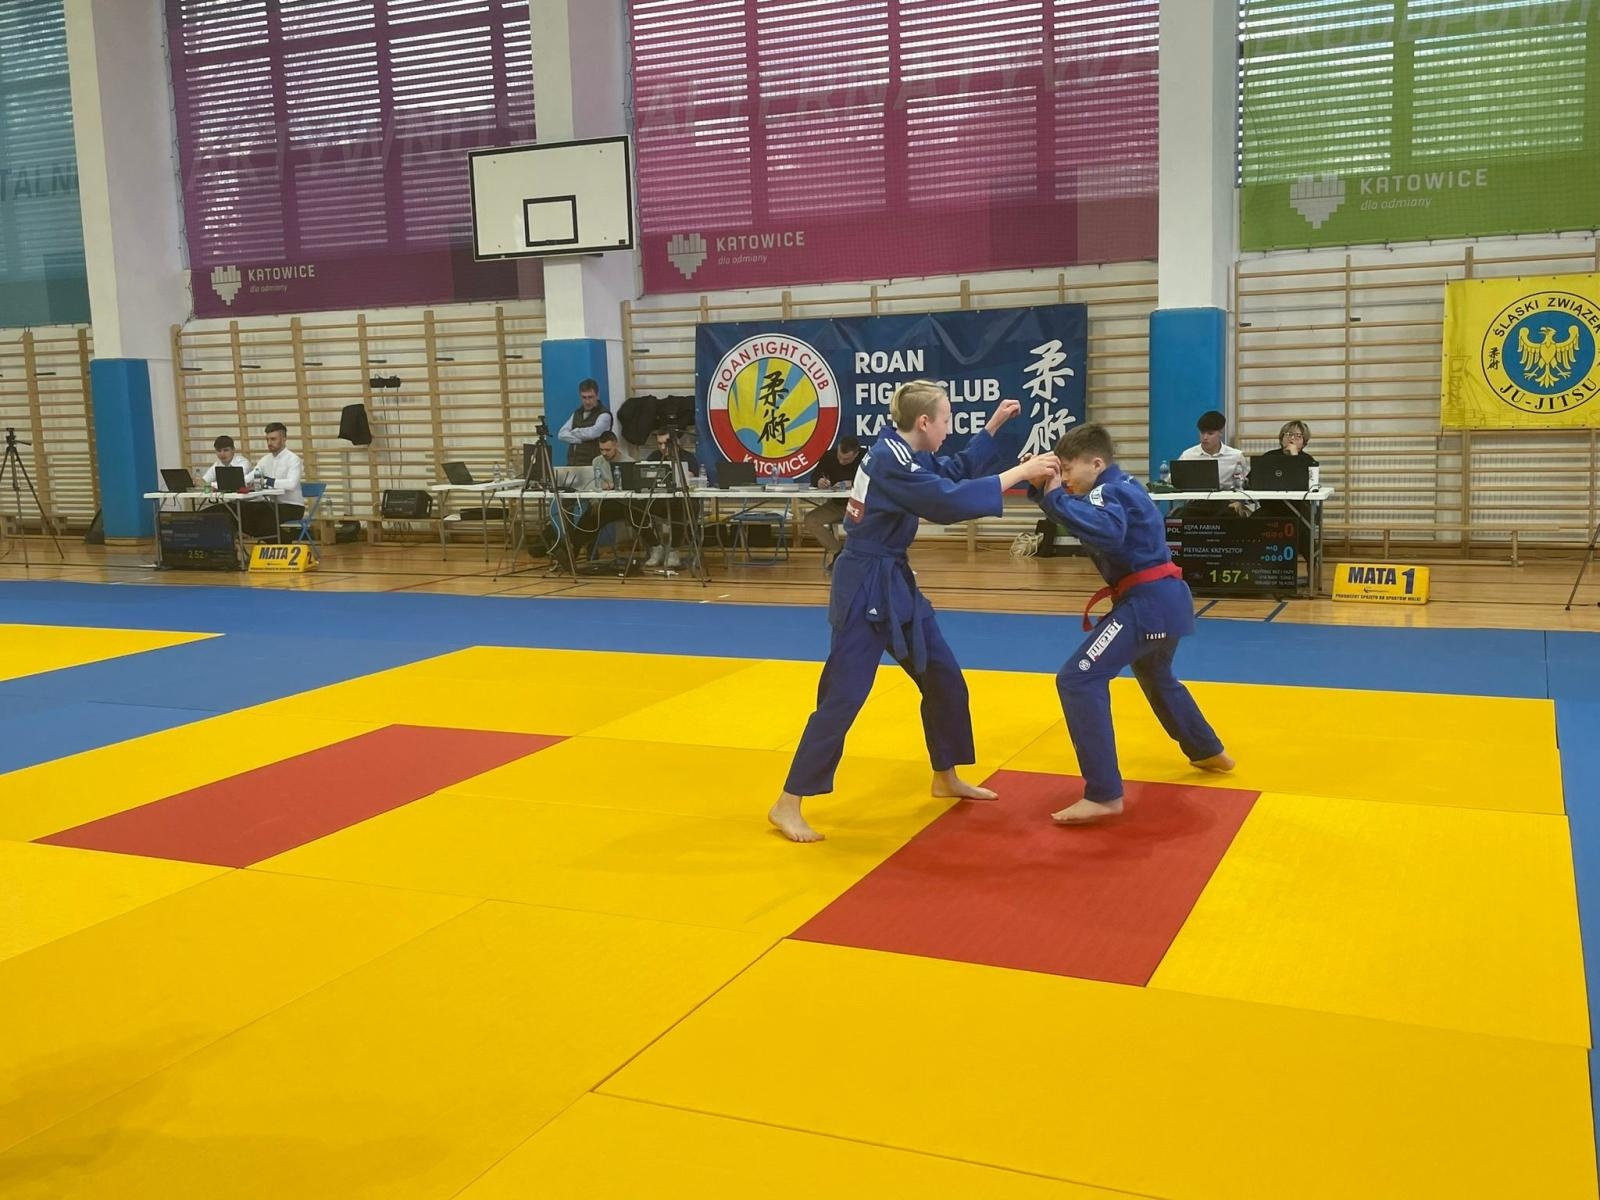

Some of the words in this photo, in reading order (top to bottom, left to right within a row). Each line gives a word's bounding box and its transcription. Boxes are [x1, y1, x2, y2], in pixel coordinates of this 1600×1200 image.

[1359, 168, 1488, 195] KATOWICE
[1381, 197, 1433, 210] odmiany
[716, 231, 805, 252] KATOWICE
[732, 254, 768, 265] odmiany
[248, 264, 316, 281] KATOWICE
[1494, 299, 1540, 337] ŚLĄSKI
[717, 349, 752, 392] ROAN
[752, 341, 799, 358] FIGHT
[799, 353, 830, 390] CLUB
[855, 349, 925, 375] ROAN
[1499, 377, 1598, 411] JU-JITSU
[259, 547, 288, 560] MATA
[288, 547, 301, 566] 2
[1284, 546, 1294, 560] 0
[1348, 567, 1397, 585] MATA
[1402, 568, 1415, 595] 1
